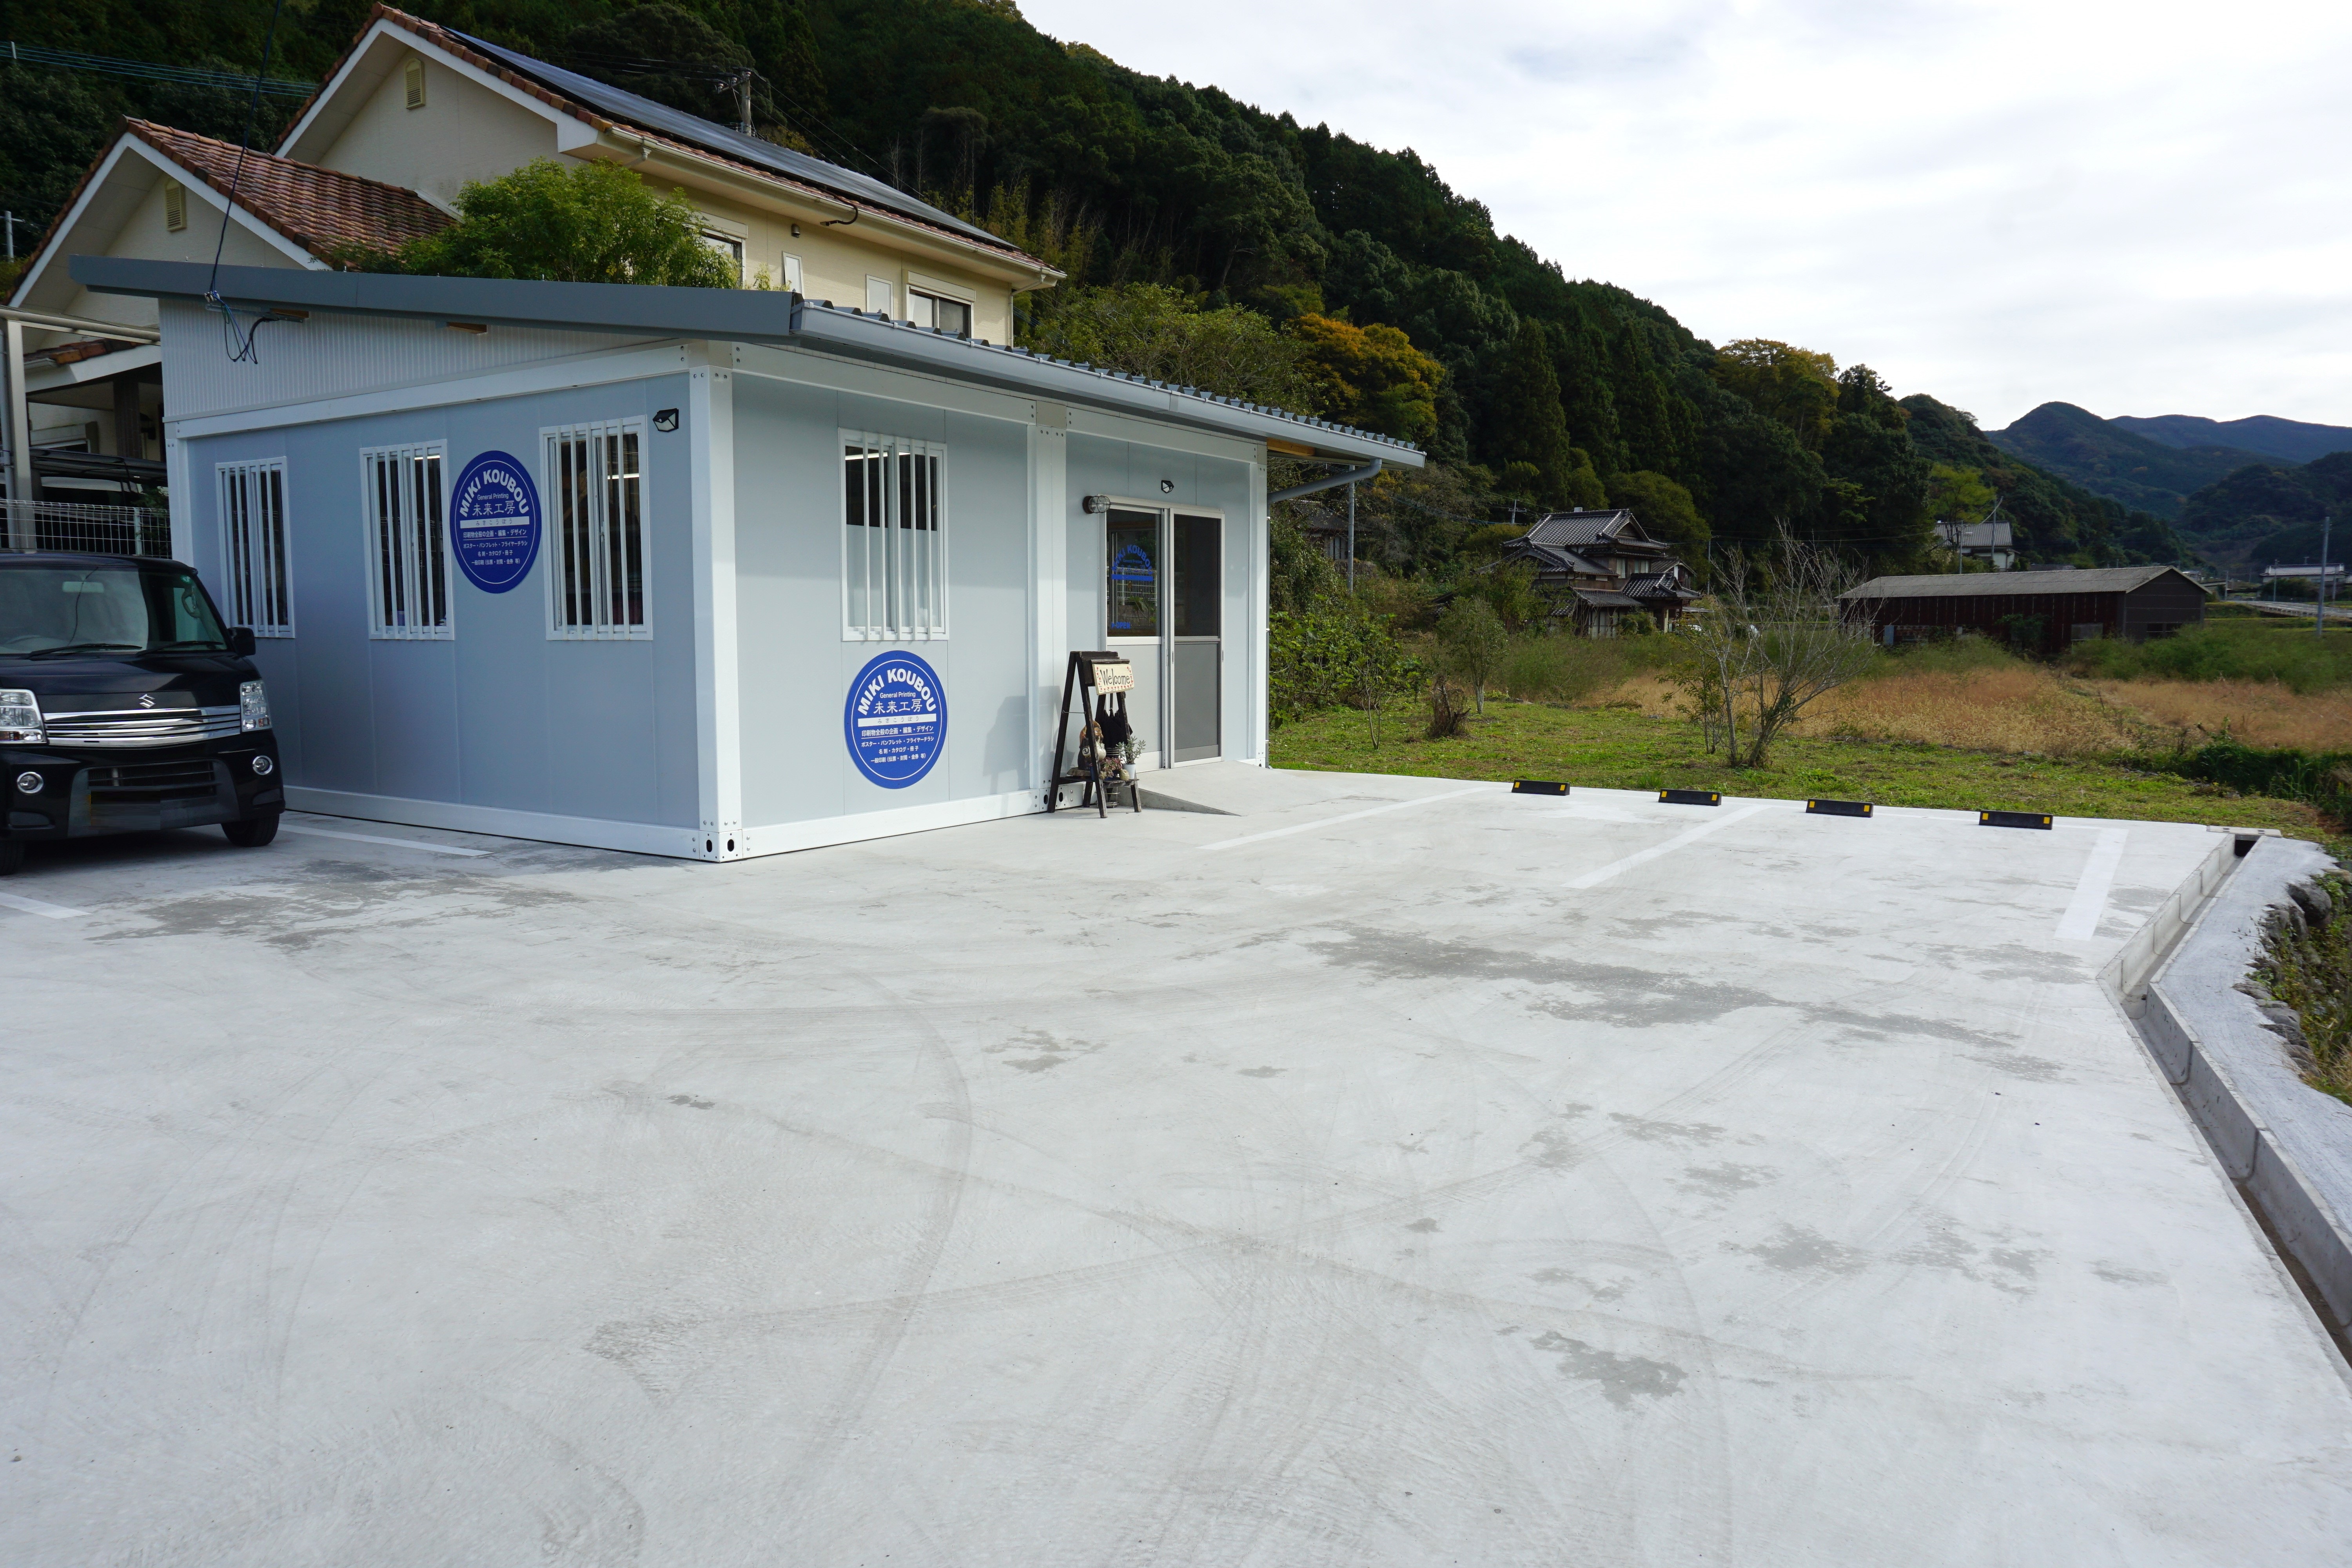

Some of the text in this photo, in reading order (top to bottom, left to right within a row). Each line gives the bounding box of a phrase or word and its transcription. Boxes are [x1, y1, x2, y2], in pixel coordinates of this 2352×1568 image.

[460, 469, 529, 517] MIKI KOUBOU
[473, 501, 515, 516] 未来工房
[1100, 668, 1130, 686] Welcome
[858, 668, 936, 715] MIKI KOUBOU
[873, 699, 922, 715] 未来工房
